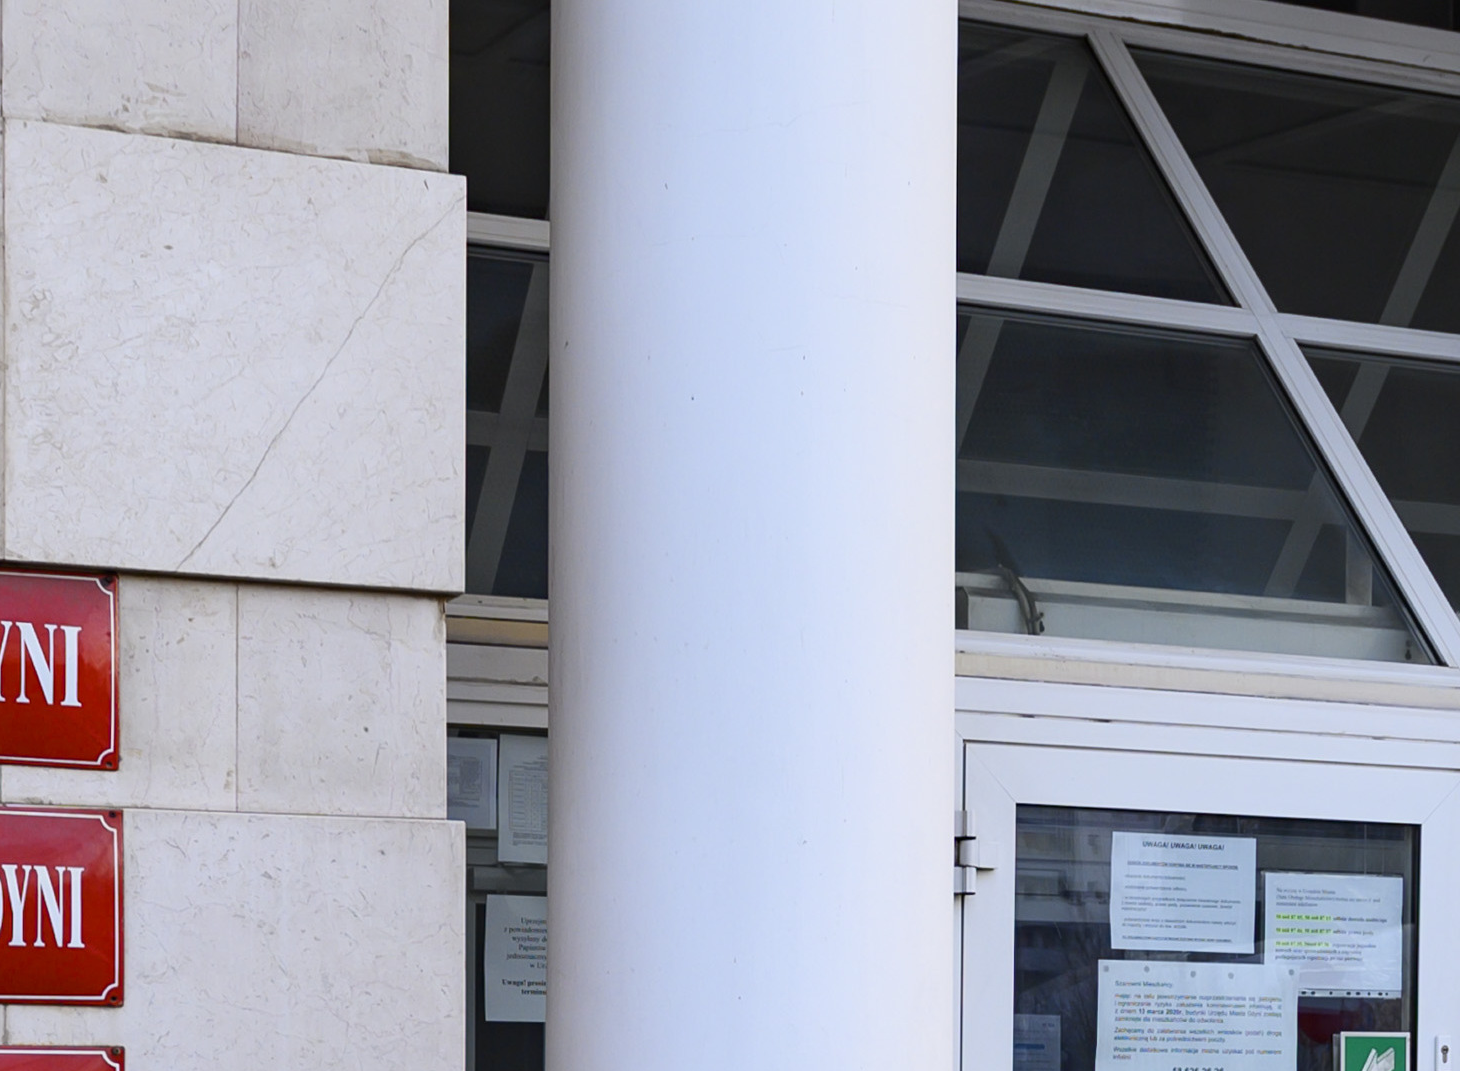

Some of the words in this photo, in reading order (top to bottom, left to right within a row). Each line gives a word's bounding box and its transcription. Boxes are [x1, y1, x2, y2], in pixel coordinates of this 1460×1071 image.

[1142, 840, 1169, 849] UWAGA!
[1170, 842, 1197, 850] UWAGA!
[1198, 843, 1225, 851] UWAGA!
